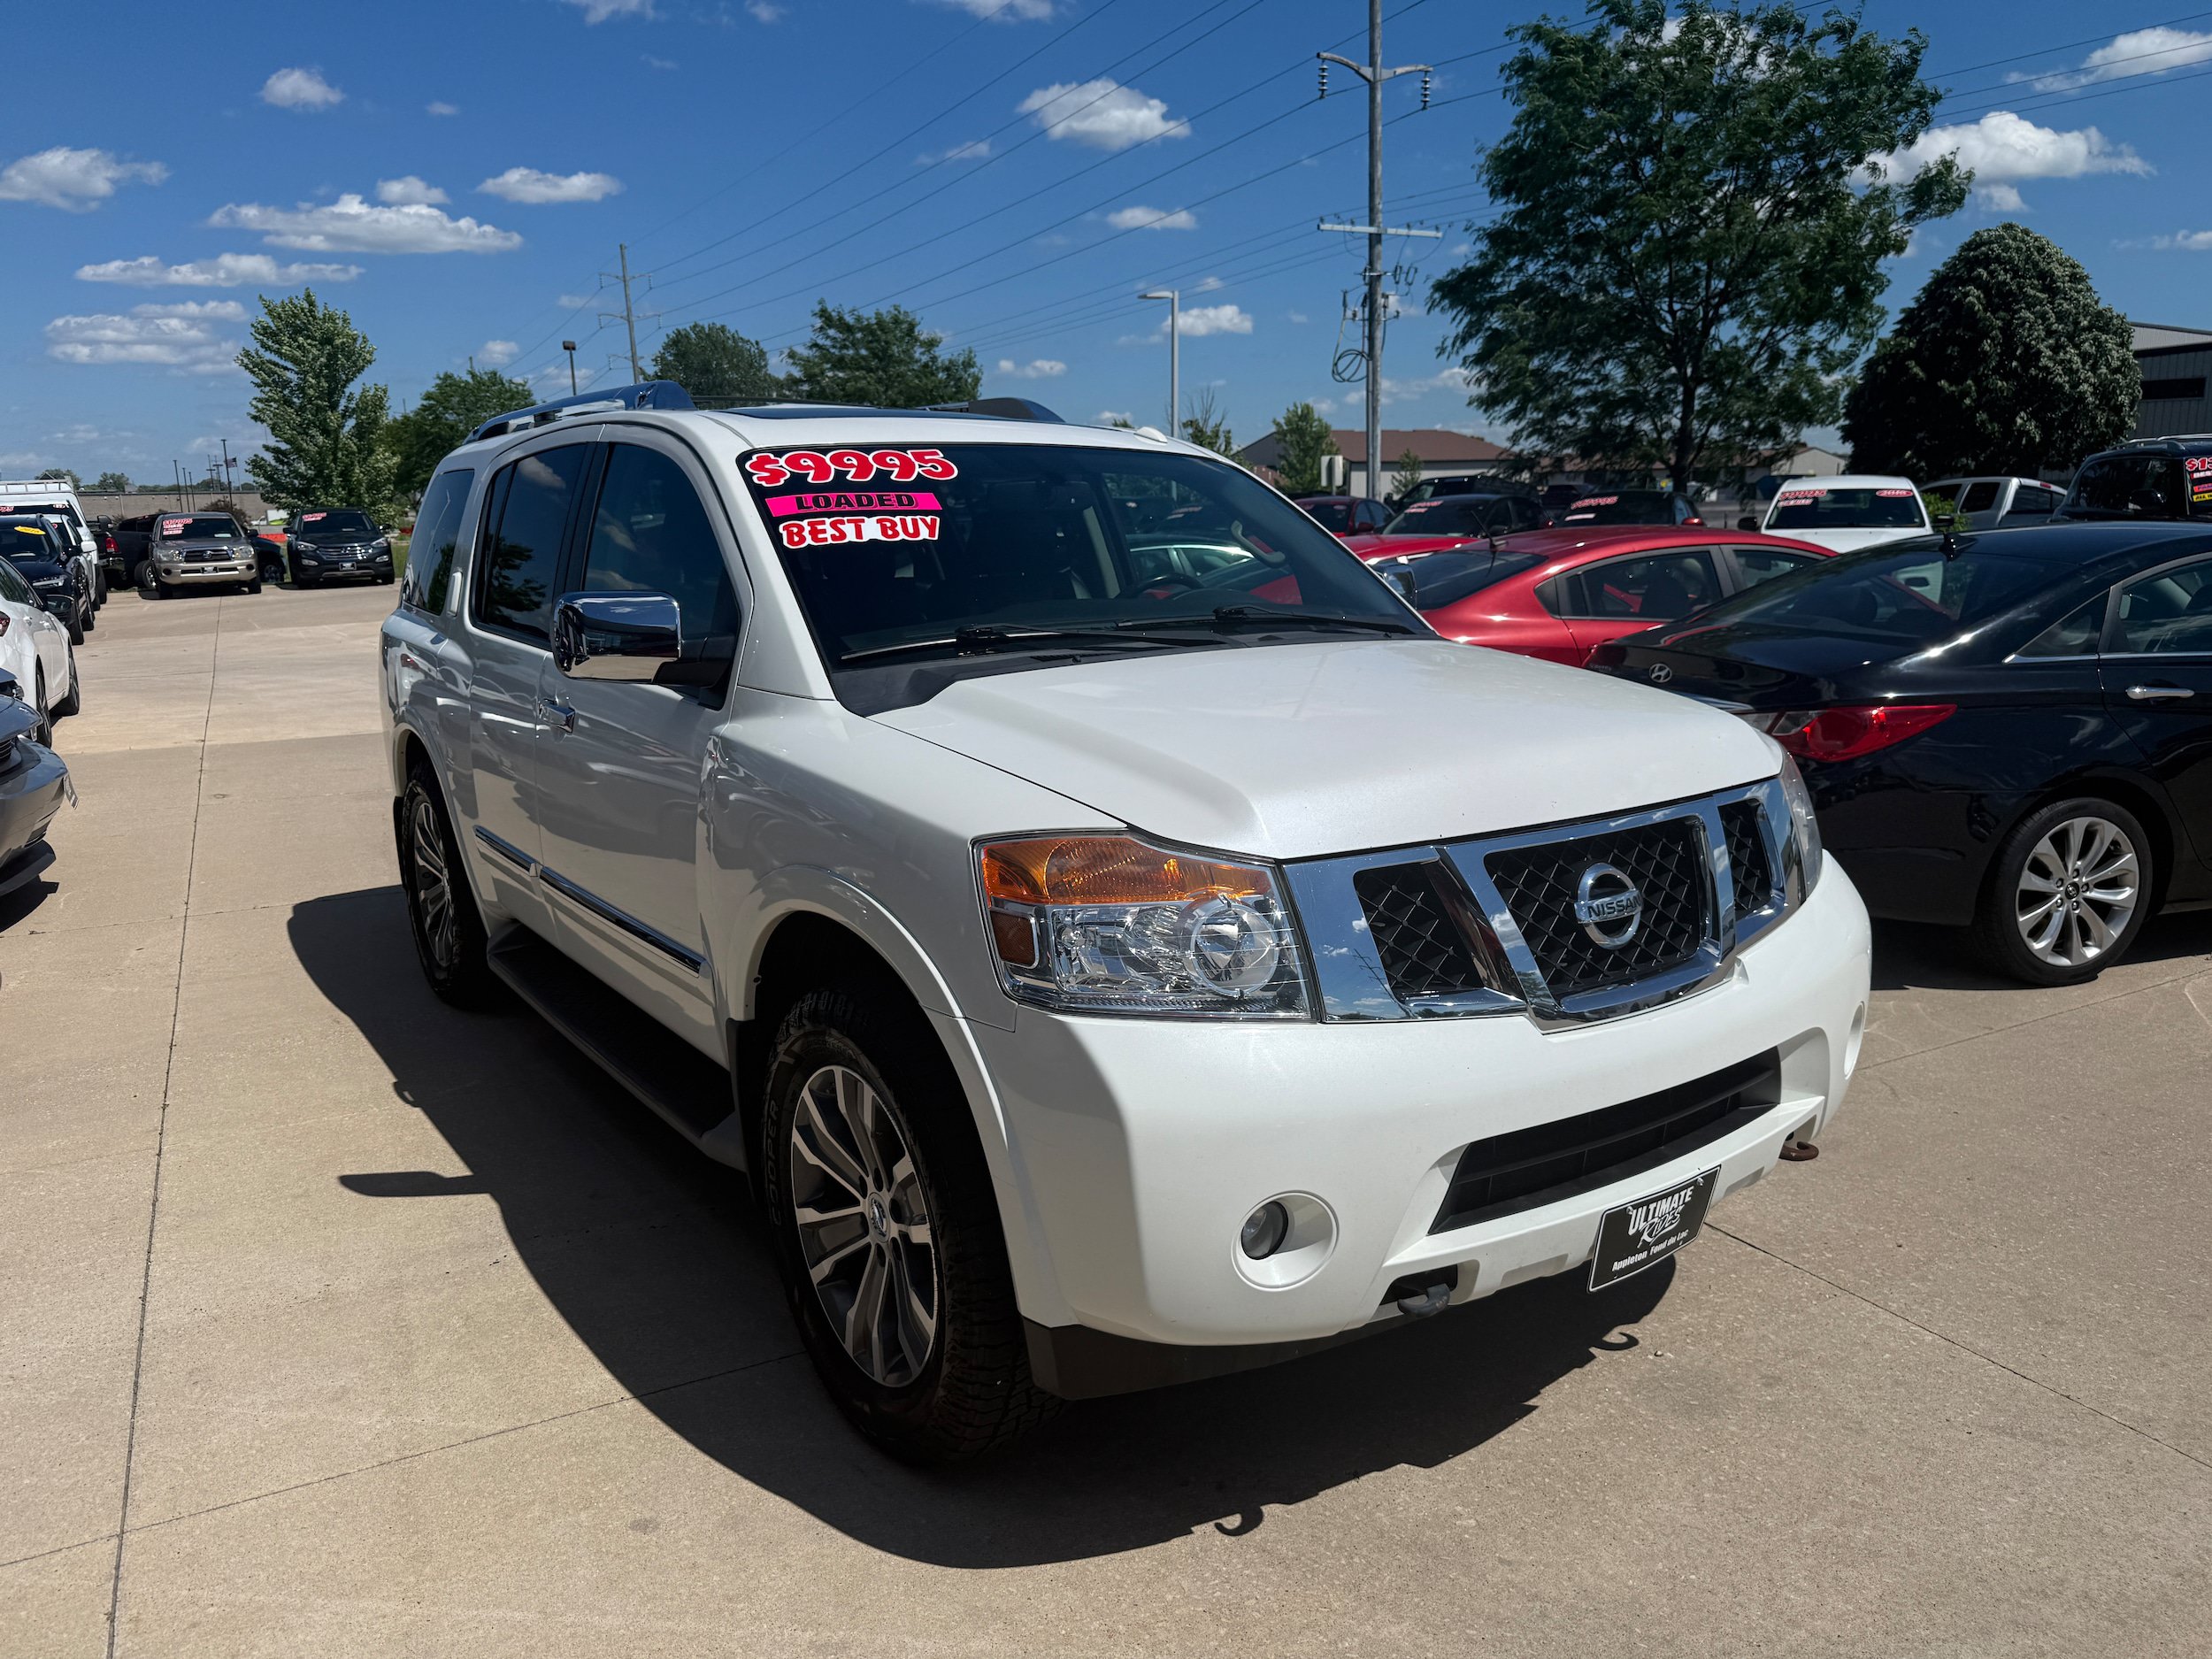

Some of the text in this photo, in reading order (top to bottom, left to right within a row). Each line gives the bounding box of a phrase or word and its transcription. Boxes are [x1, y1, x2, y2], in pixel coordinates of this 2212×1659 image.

[745, 449, 958, 488] $9995
[795, 494, 919, 511] LOADED
[780, 516, 939, 548] BEST BUY
[1586, 895, 1642, 918] NISSAN
[1628, 1186, 1695, 1236] ULTIMATE
[1637, 1204, 1686, 1248] RIDES
[1612, 1229, 1689, 1272] Appleton Fond du Lac
